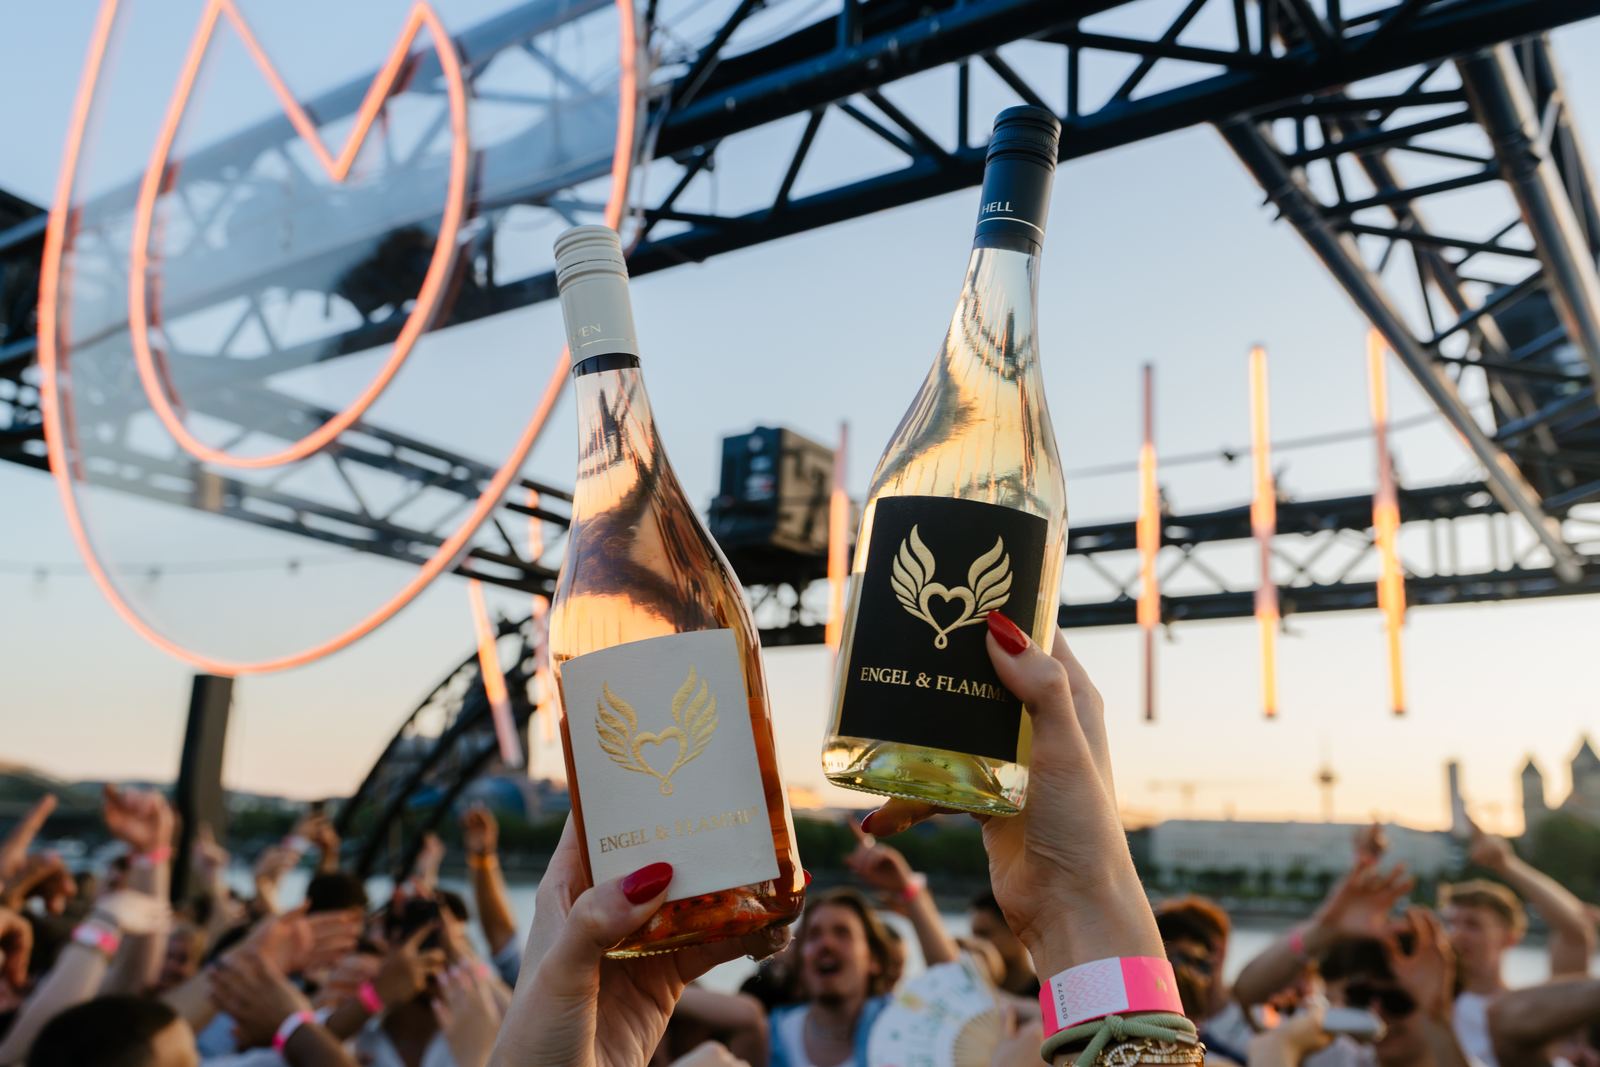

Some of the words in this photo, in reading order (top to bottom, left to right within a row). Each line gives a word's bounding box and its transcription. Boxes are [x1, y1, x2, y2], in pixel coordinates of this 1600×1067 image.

[982, 201, 1014, 215] HELL
[860, 666, 911, 686] ENGEL
[915, 672, 931, 689] &
[600, 828, 650, 854] ENGEL
[655, 824, 671, 841] &
